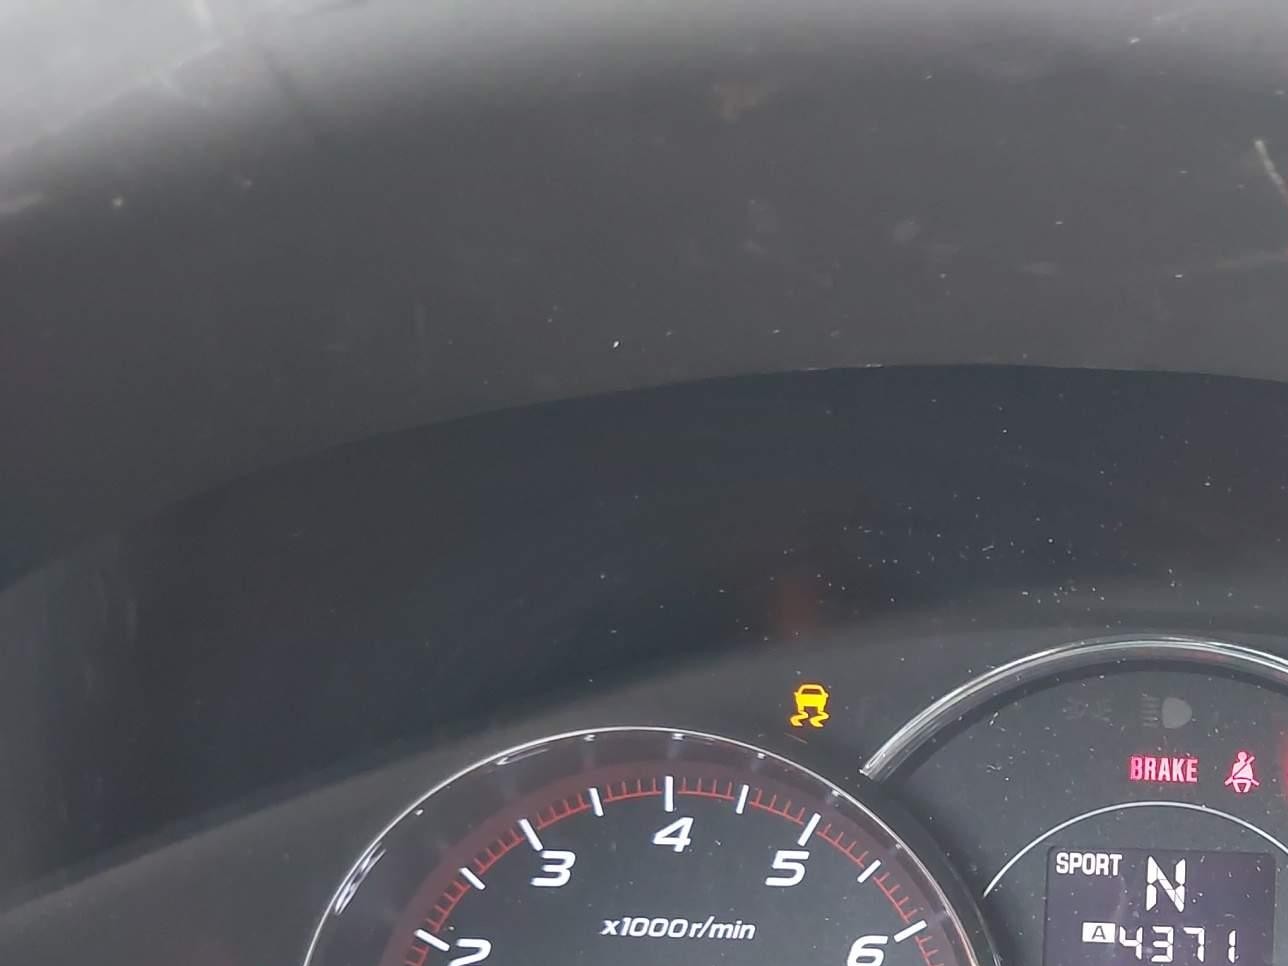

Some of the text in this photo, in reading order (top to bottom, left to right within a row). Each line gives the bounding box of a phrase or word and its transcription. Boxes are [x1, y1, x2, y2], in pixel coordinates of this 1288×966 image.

[1131, 757, 1197, 782] BRAKE
[653, 818, 693, 852] 4
[531, 851, 575, 886] 3
[766, 851, 809, 886] 5
[1057, 853, 1122, 875] SPORT
[1147, 857, 1185, 912] N
[1119, 926, 1235, 962] 4371
